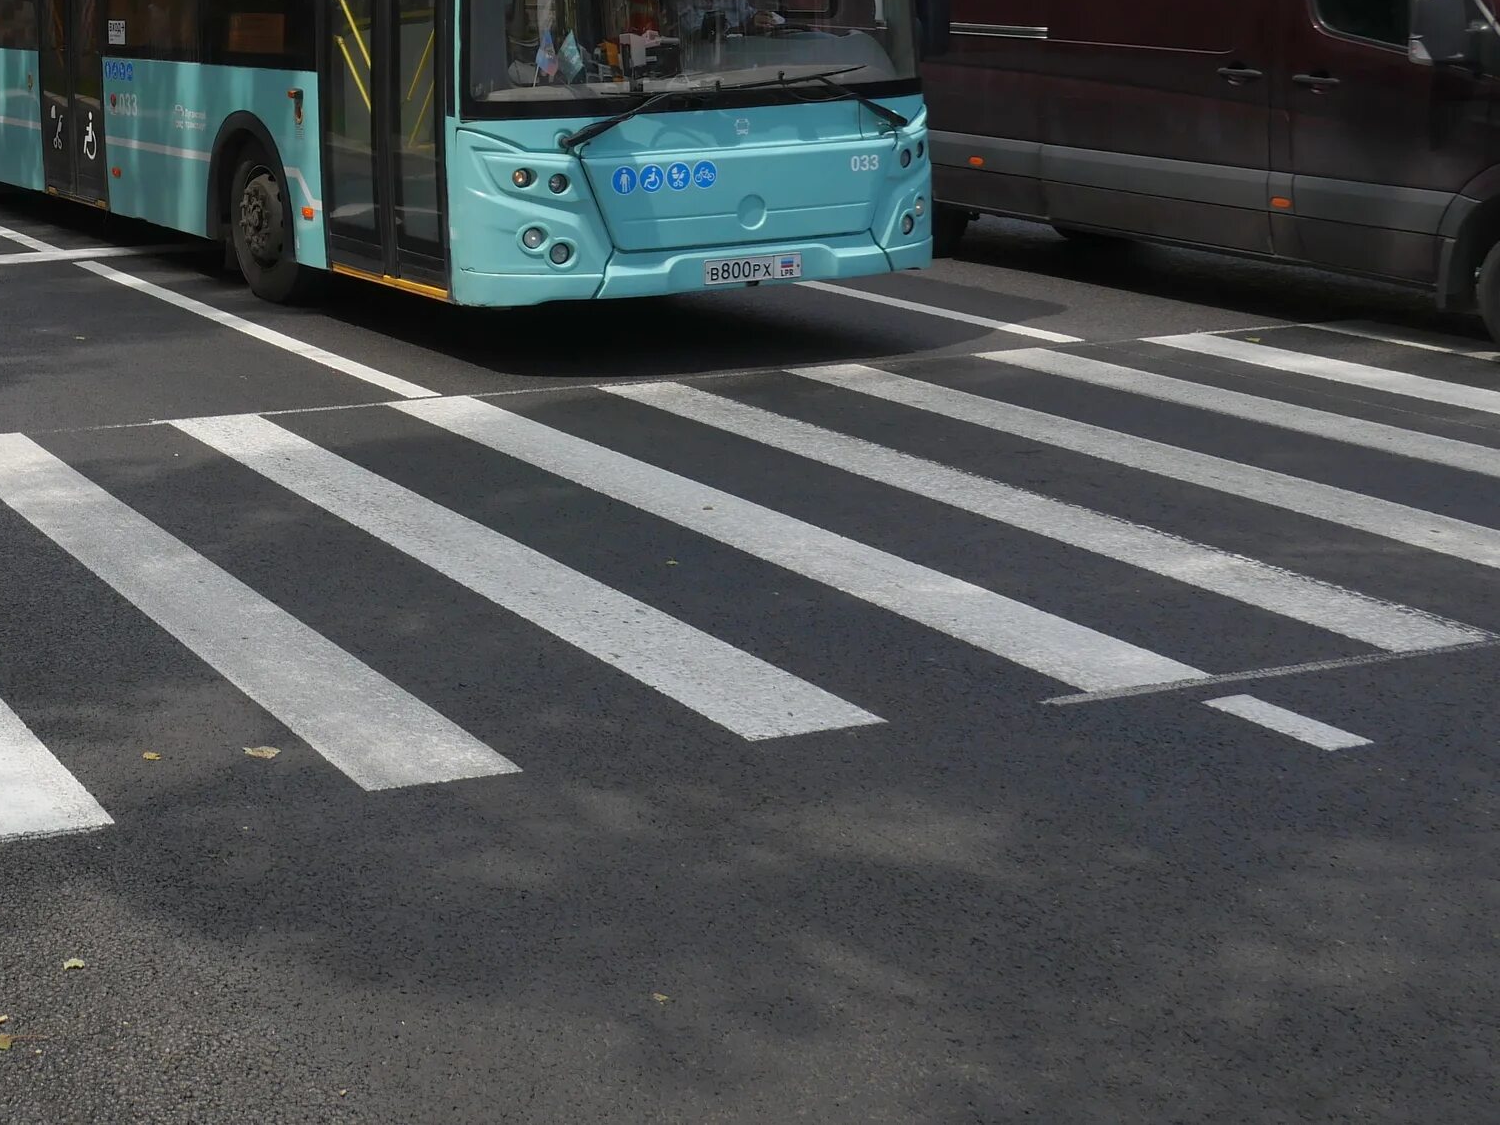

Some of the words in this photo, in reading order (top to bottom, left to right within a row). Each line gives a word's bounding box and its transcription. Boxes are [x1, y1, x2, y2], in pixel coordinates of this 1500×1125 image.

[119, 93, 138, 117] 033
[850, 154, 880, 172] 033
[780, 268, 794, 277] LPR
